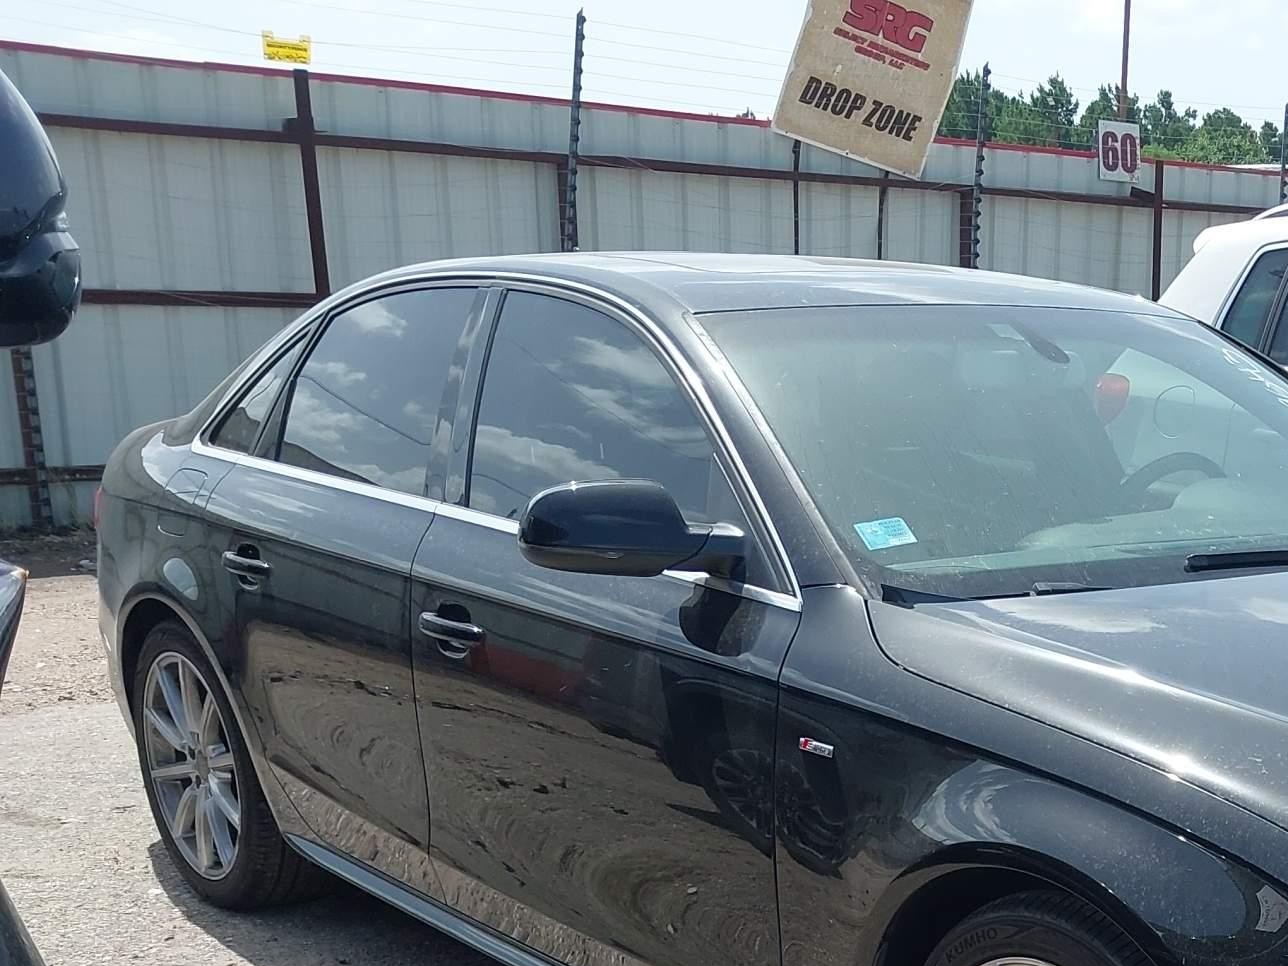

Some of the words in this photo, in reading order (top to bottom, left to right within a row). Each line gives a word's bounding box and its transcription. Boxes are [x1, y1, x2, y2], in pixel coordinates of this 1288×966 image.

[842, 0, 934, 53] SRG
[798, 76, 867, 119] DROP
[861, 100, 922, 141] ZONE
[1102, 131, 1137, 173] 60
[945, 928, 998, 963] KUMHO
